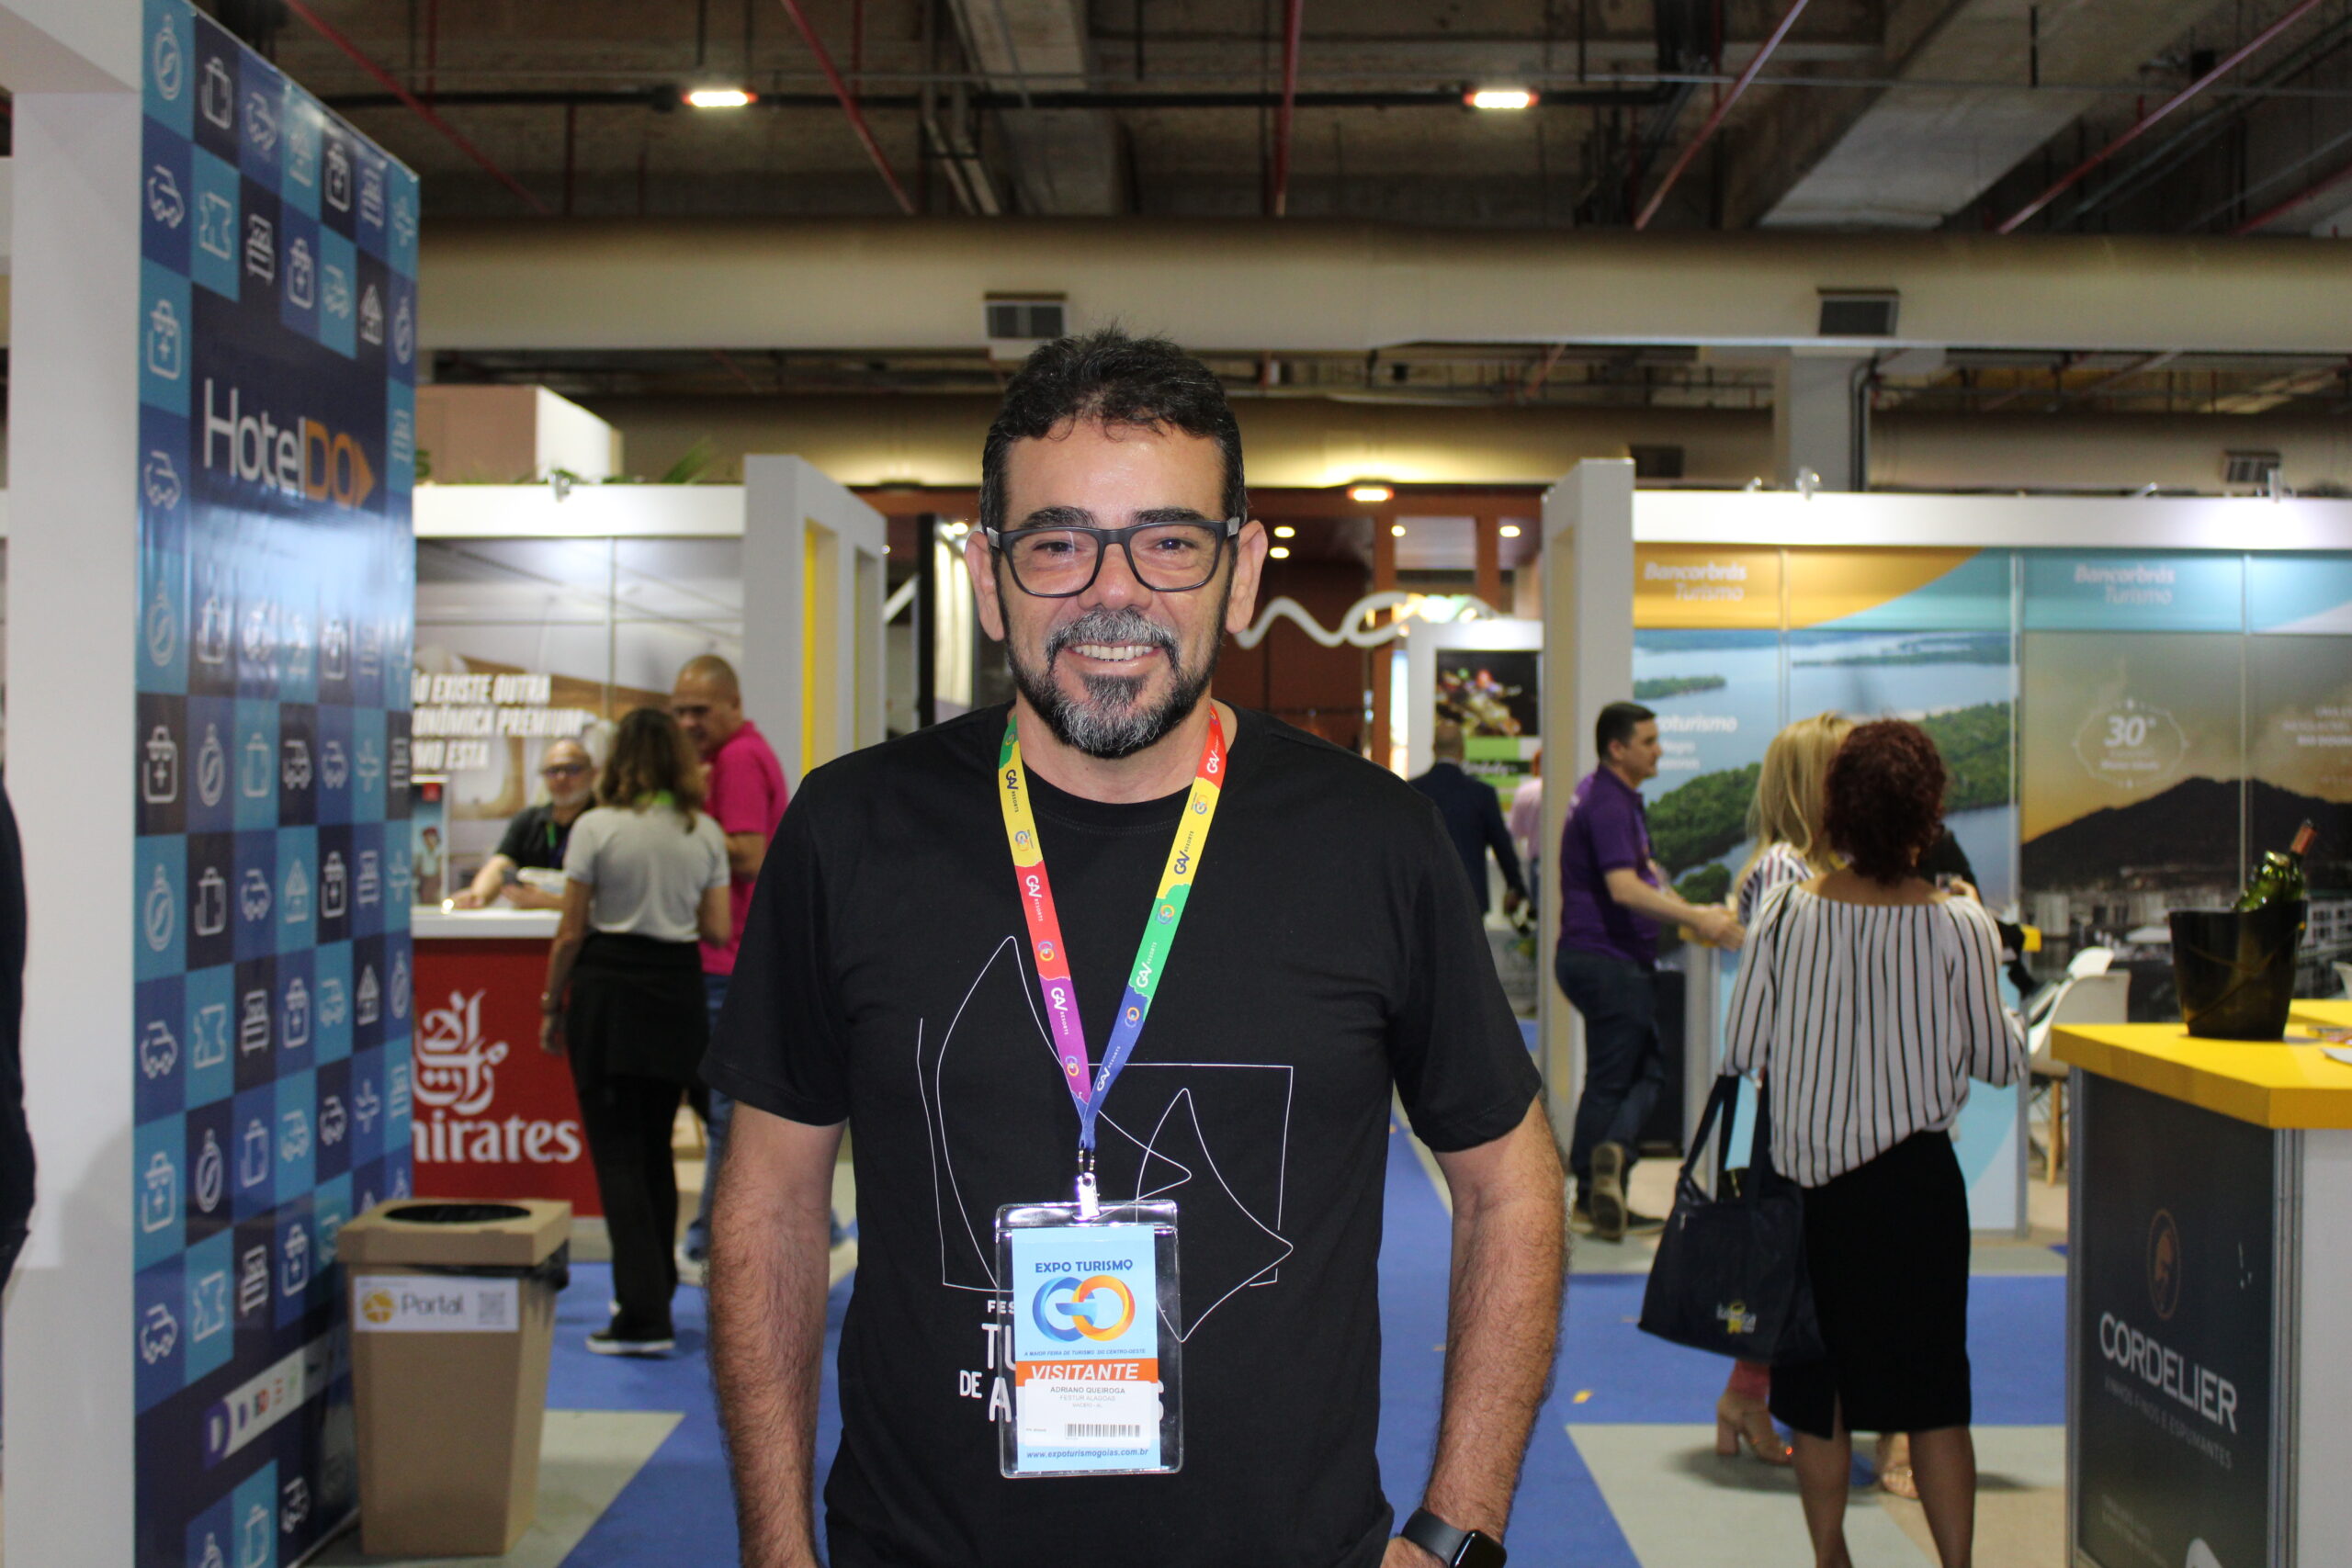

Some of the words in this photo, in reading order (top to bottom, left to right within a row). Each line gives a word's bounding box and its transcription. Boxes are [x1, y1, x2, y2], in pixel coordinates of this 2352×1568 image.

[1675, 582, 1744, 602] Turismo
[2105, 585, 2173, 604] Turismo
[431, 673, 492, 704] EXISTE
[492, 673, 551, 705] OUTRA
[495, 708, 585, 738] PREMIUM
[445, 739, 490, 771] ESTA
[1006, 769, 1019, 790] GAV
[1173, 851, 1191, 875] GAV
[1184, 829, 1194, 852] RESORTS
[1025, 874, 1042, 898] GAV
[1034, 898, 1044, 921] RESORTS
[1136, 962, 1152, 987] GAV
[1147, 942, 1158, 964] RESORTS
[1051, 987, 1068, 1011] GAV
[1059, 1011, 1069, 1035] RESORTS
[1097, 1067, 1111, 1091] GAV
[1108, 1045, 1121, 1068] RESORTS
[1035, 1262, 1071, 1273] EXPO
[1076, 1259, 1134, 1272] TURISMO
[401, 1293, 464, 1316] Portal
[1031, 1363, 1140, 1380] VISITANTE
[2099, 1310, 2237, 1434] CORDELIER
[959, 1370, 983, 1399] DE
[1086, 1386, 1125, 1394] QUEIROGA
[1026, 1448, 1148, 1460] www.expoturismogoias.com.br
